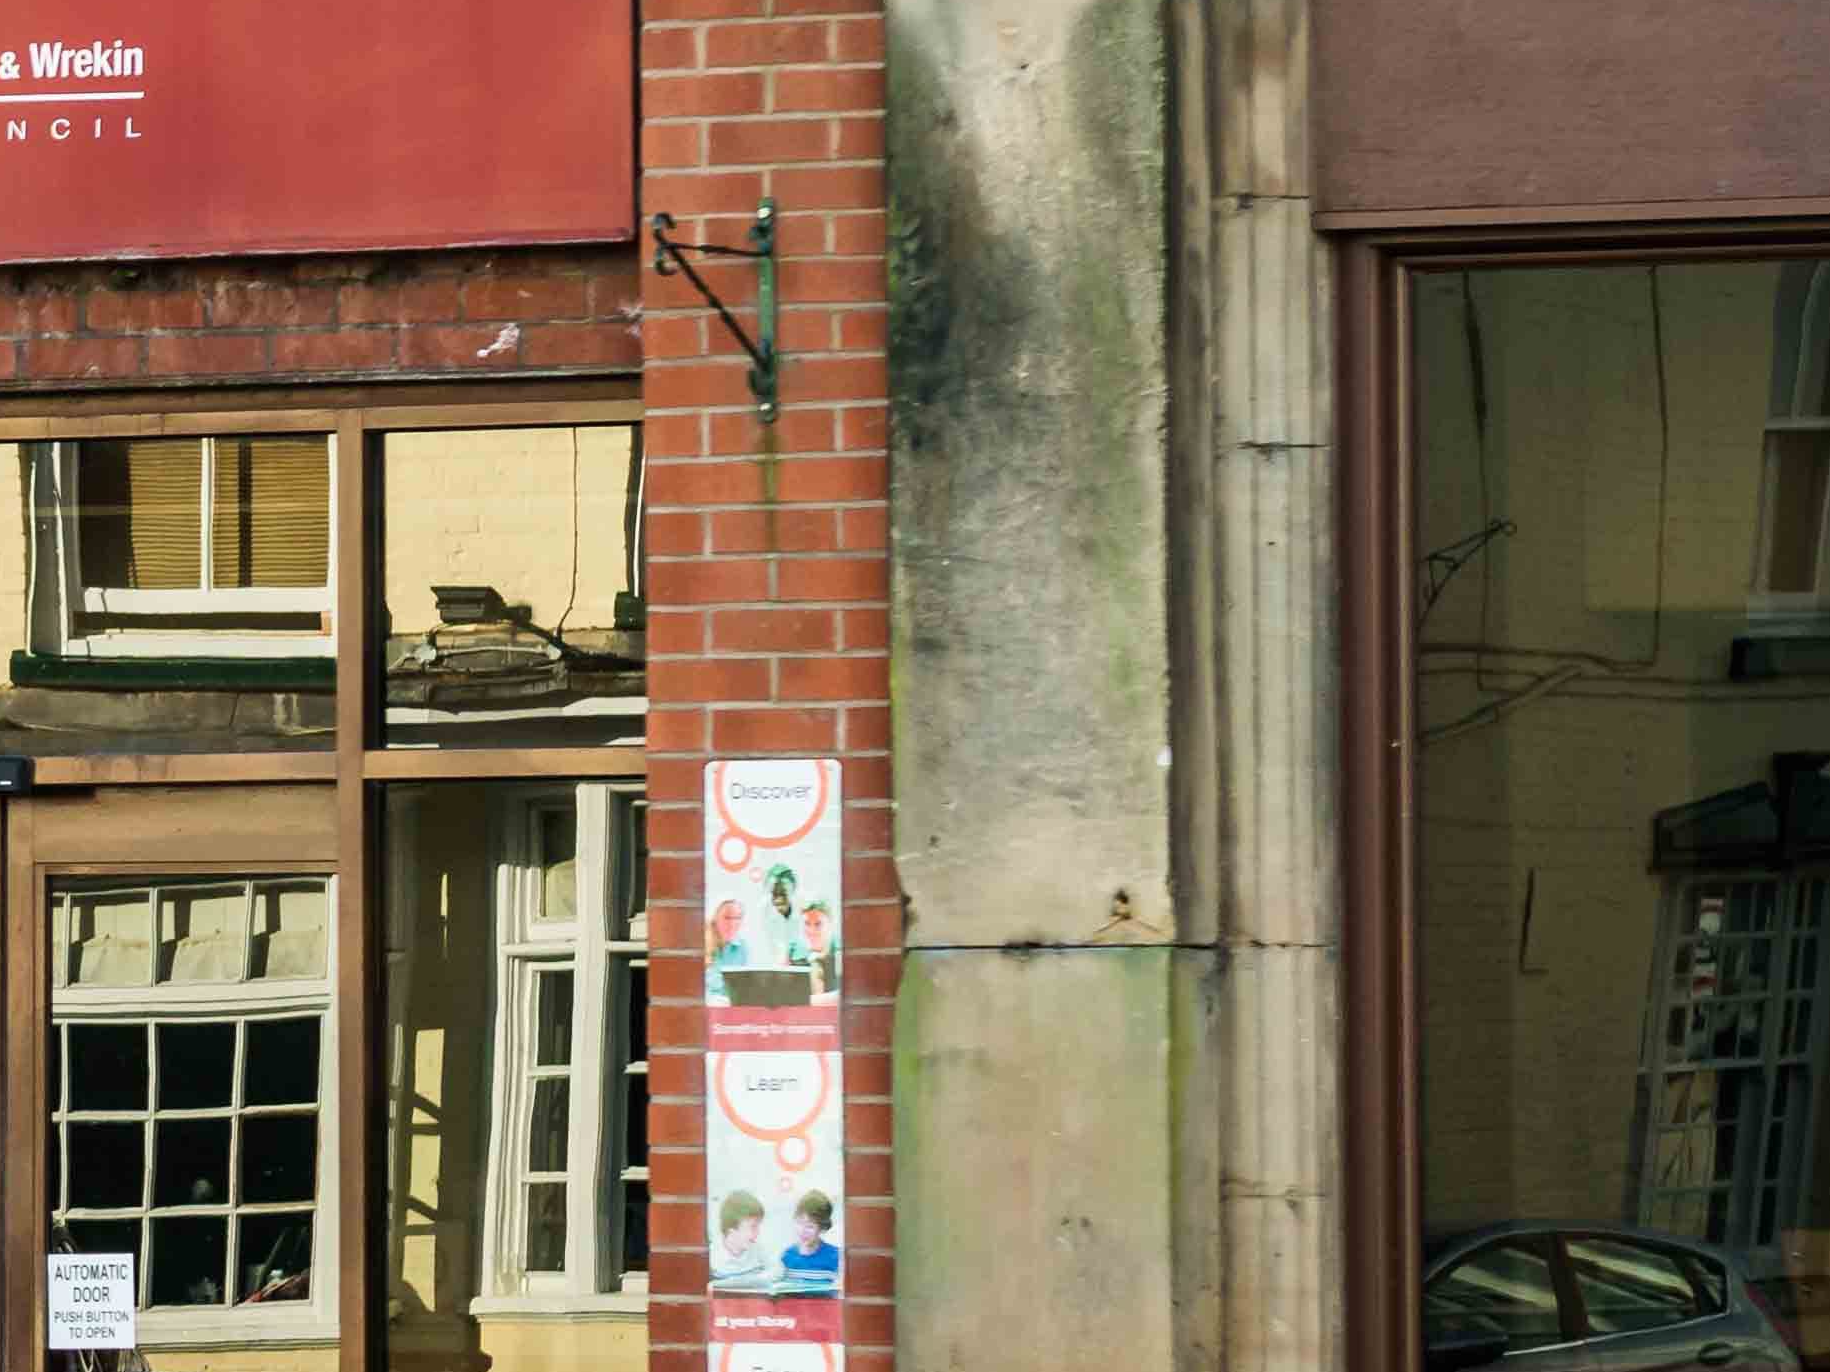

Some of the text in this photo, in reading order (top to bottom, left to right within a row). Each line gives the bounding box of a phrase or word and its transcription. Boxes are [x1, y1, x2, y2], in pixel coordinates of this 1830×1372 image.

[29, 40, 143, 79] Wrekin
[731, 782, 812, 800] Discover
[745, 1074, 798, 1092] Learn
[54, 1263, 128, 1281] AUTOMATIC
[73, 1286, 110, 1303] DOOR
[54, 1311, 129, 1323] PUSH BUTTON
[69, 1327, 116, 1339] TO OPEN
